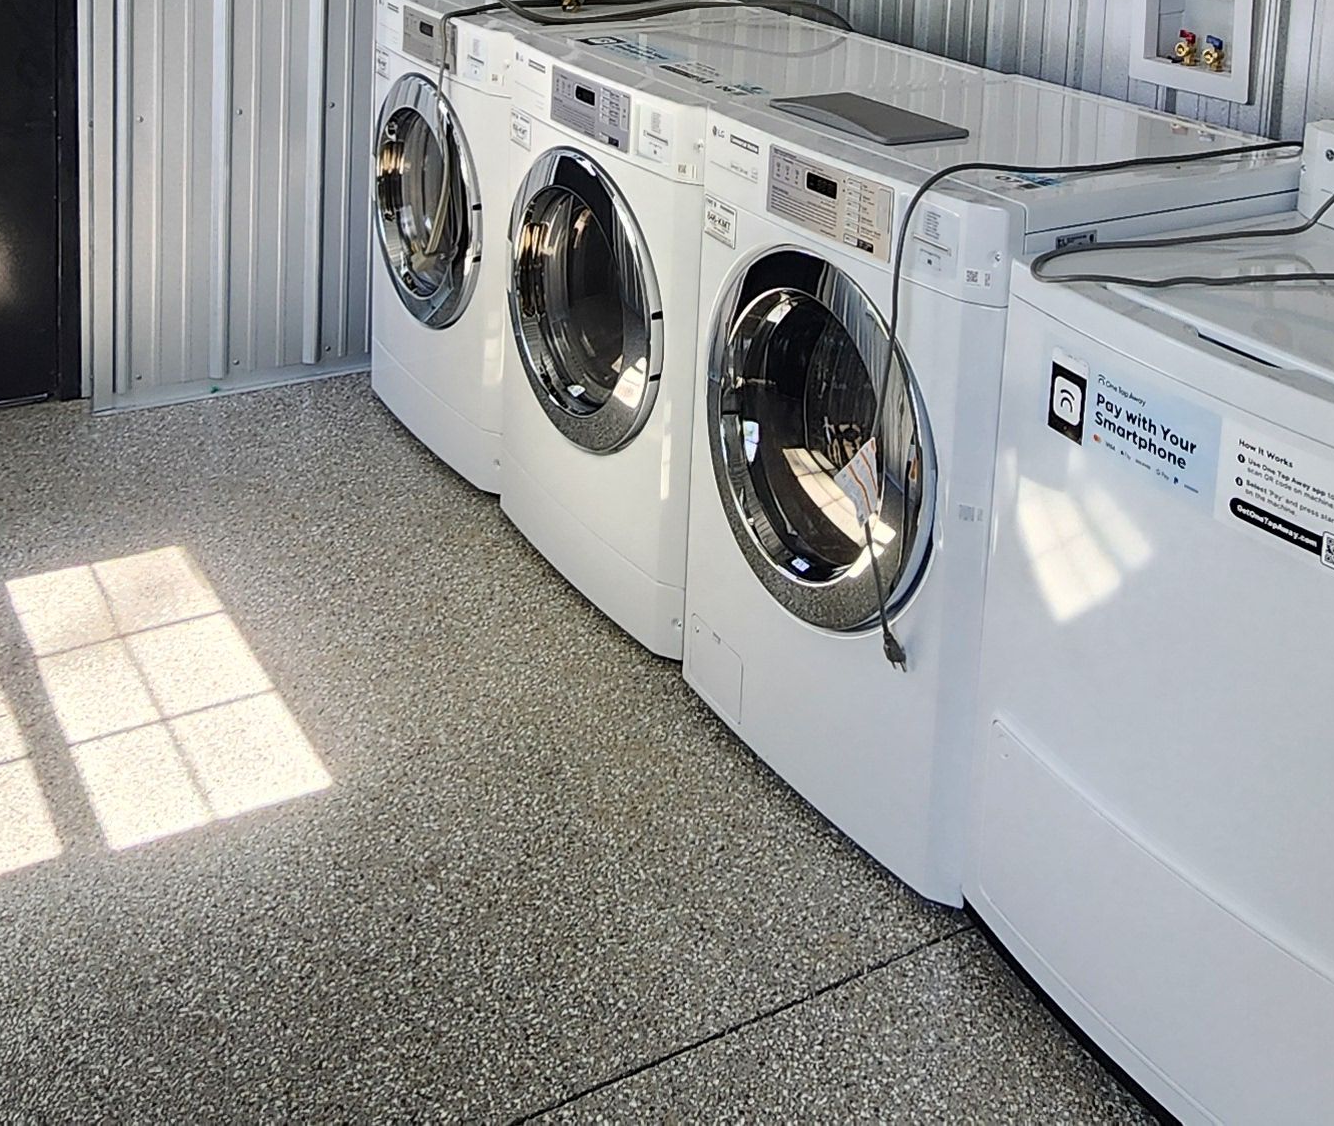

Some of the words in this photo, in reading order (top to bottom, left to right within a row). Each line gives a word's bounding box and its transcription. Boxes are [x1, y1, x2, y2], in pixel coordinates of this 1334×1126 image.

[718, 129, 725, 138] LG
[1105, 381, 1117, 392] One
[1118, 386, 1128, 398] Tap
[1129, 393, 1146, 407] Away
[1096, 392, 1122, 419] Pay
[1126, 410, 1157, 436] with
[1160, 424, 1197, 454] Your
[1094, 411, 1186, 470] Smartphone
[1238, 438, 1257, 452] How
[1258, 447, 1264, 455] It
[1266, 450, 1293, 468] Works
[1245, 488, 1253, 496] on
[1254, 491, 1265, 503] the
[1247, 467, 1263, 478] scan
[1264, 474, 1274, 483] QR
[1275, 480, 1292, 491] code
[1294, 487, 1303, 495] on
[1248, 457, 1261, 469] Use
[1262, 464, 1276, 475] One
[1277, 470, 1290, 482] Tap
[1291, 477, 1311, 491] Away
[1312, 486, 1326, 497] app
[1327, 491, 1334, 500] to
[1245, 479, 1267, 495] Select
[1285, 496, 1298, 508] and
[1299, 503, 1320, 518] press
[1236, 504, 1317, 548] GetOneTapAway.com
